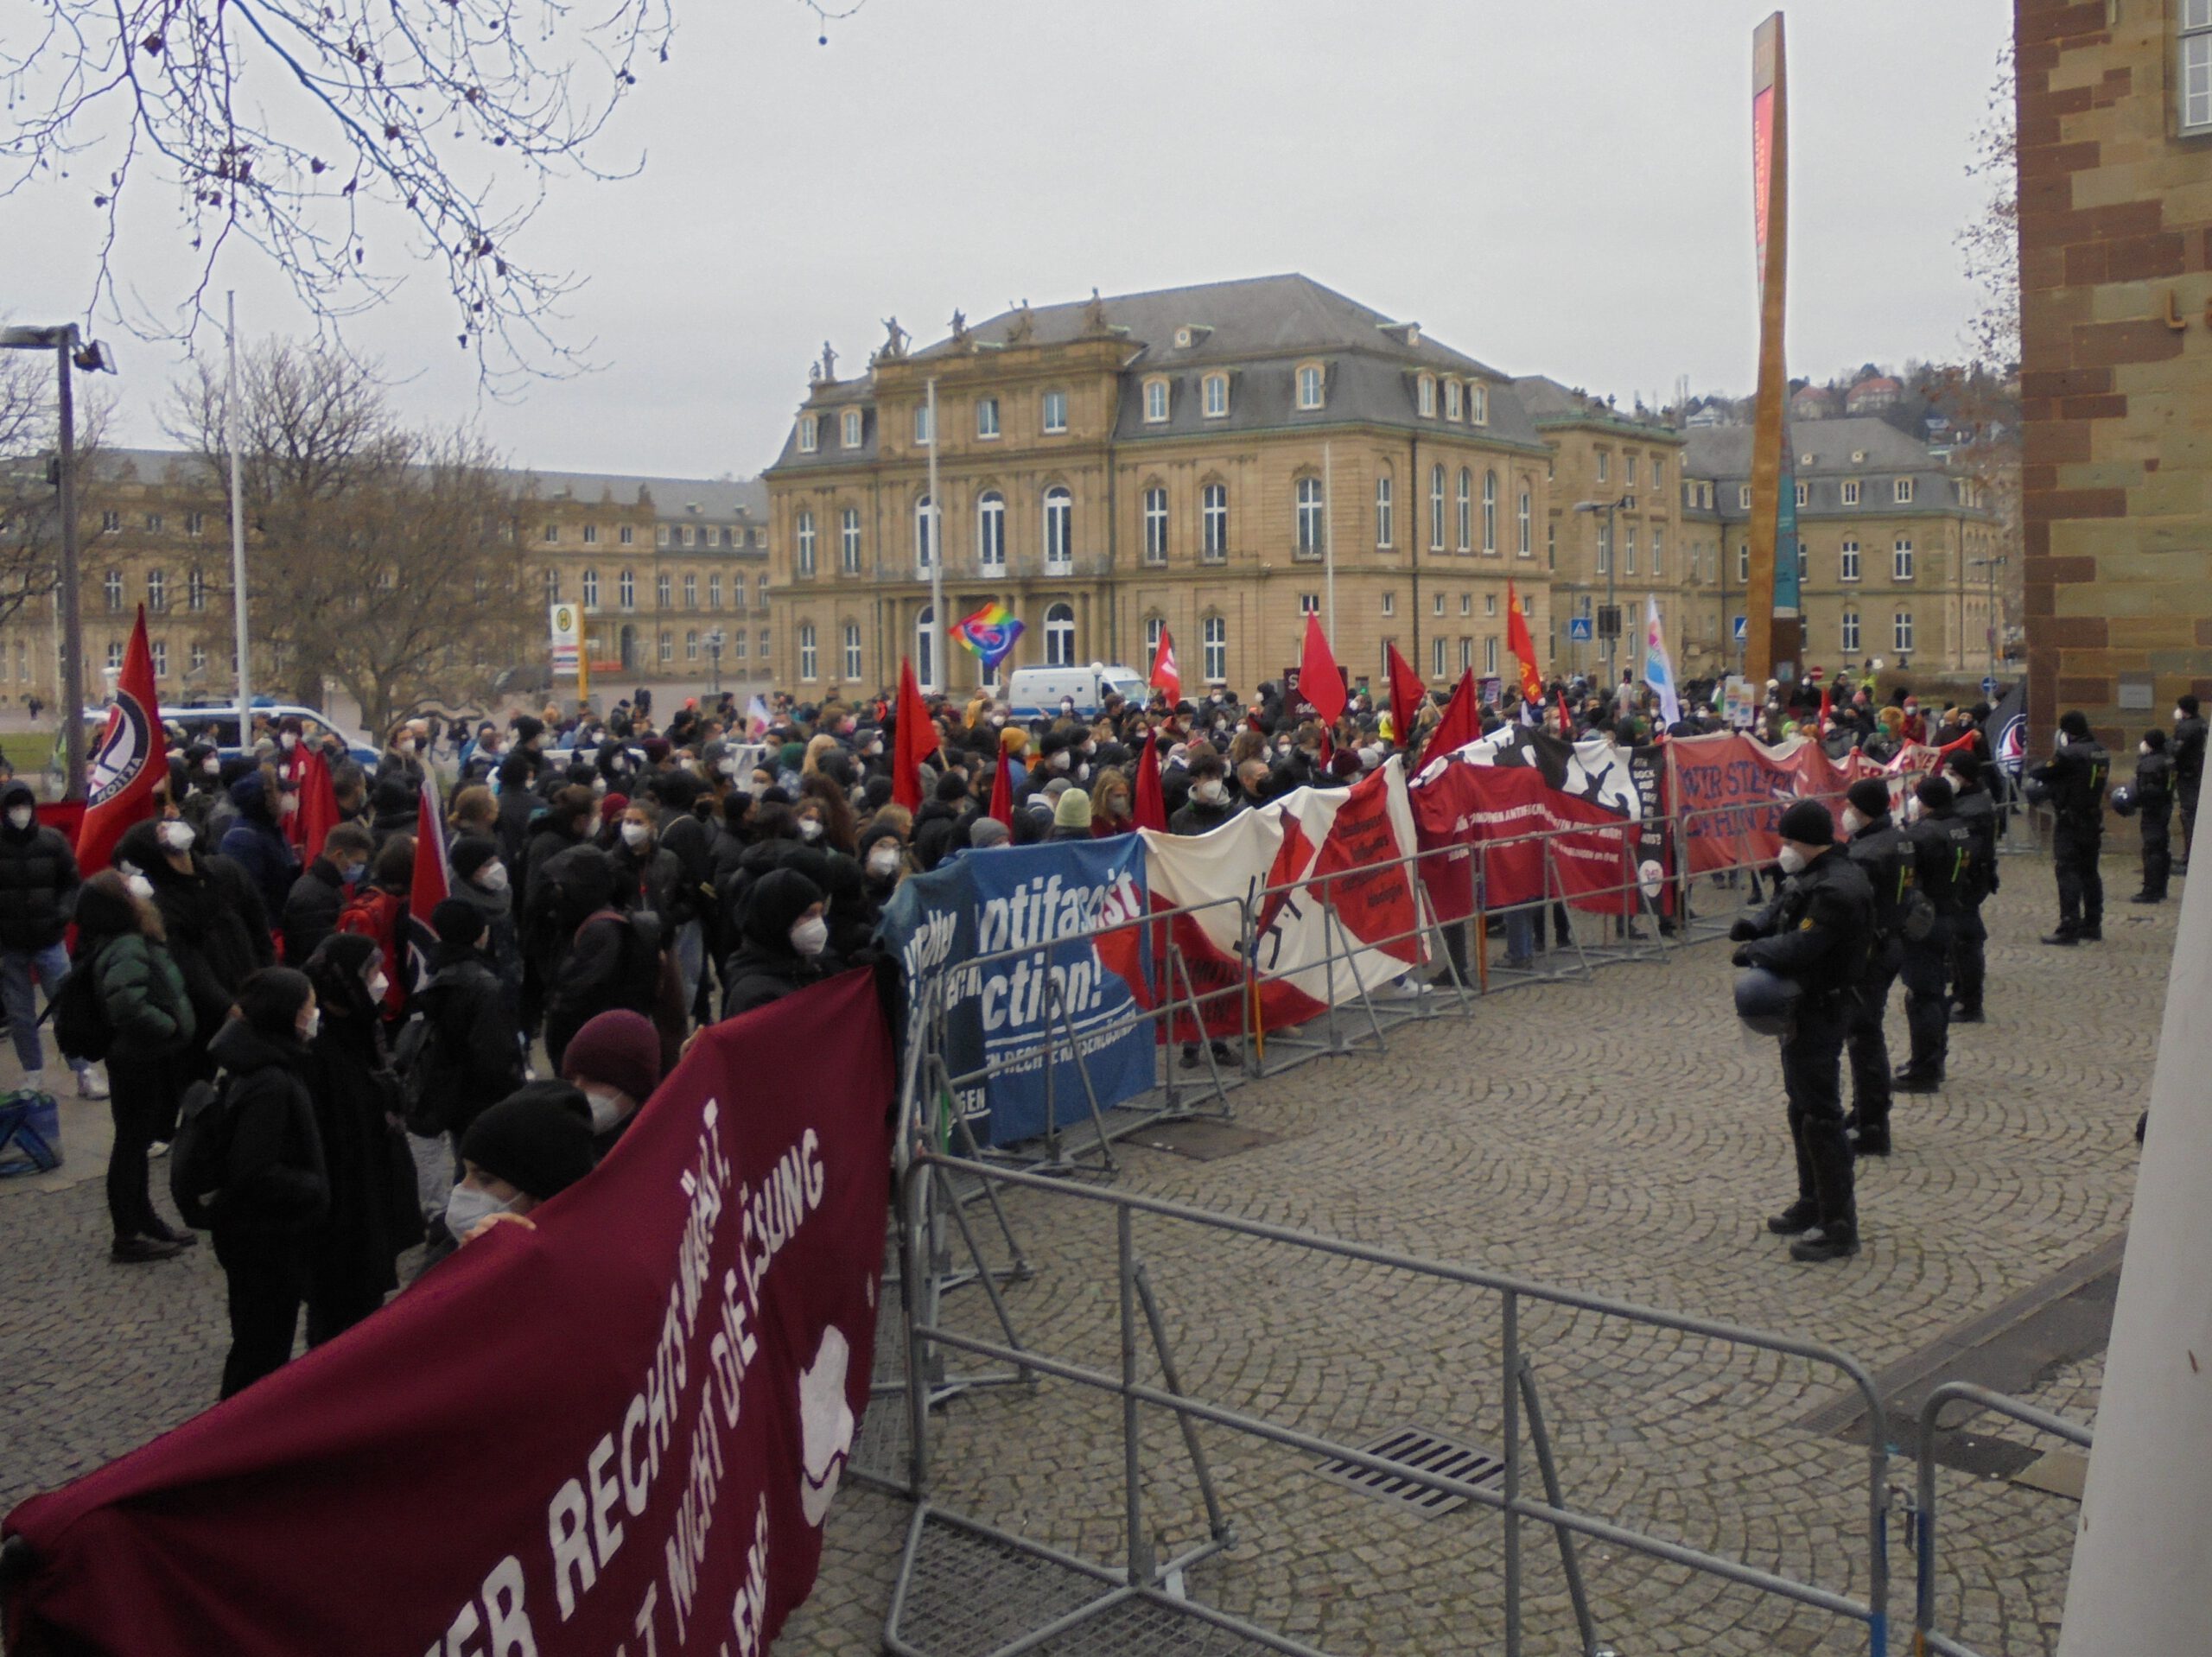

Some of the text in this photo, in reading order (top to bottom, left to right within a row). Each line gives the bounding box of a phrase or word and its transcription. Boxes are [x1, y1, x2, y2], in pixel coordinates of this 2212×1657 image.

[975, 867, 1141, 953] ntifascist
[982, 952, 1102, 1031] ction!
[710, 1267, 758, 1430] DIE
